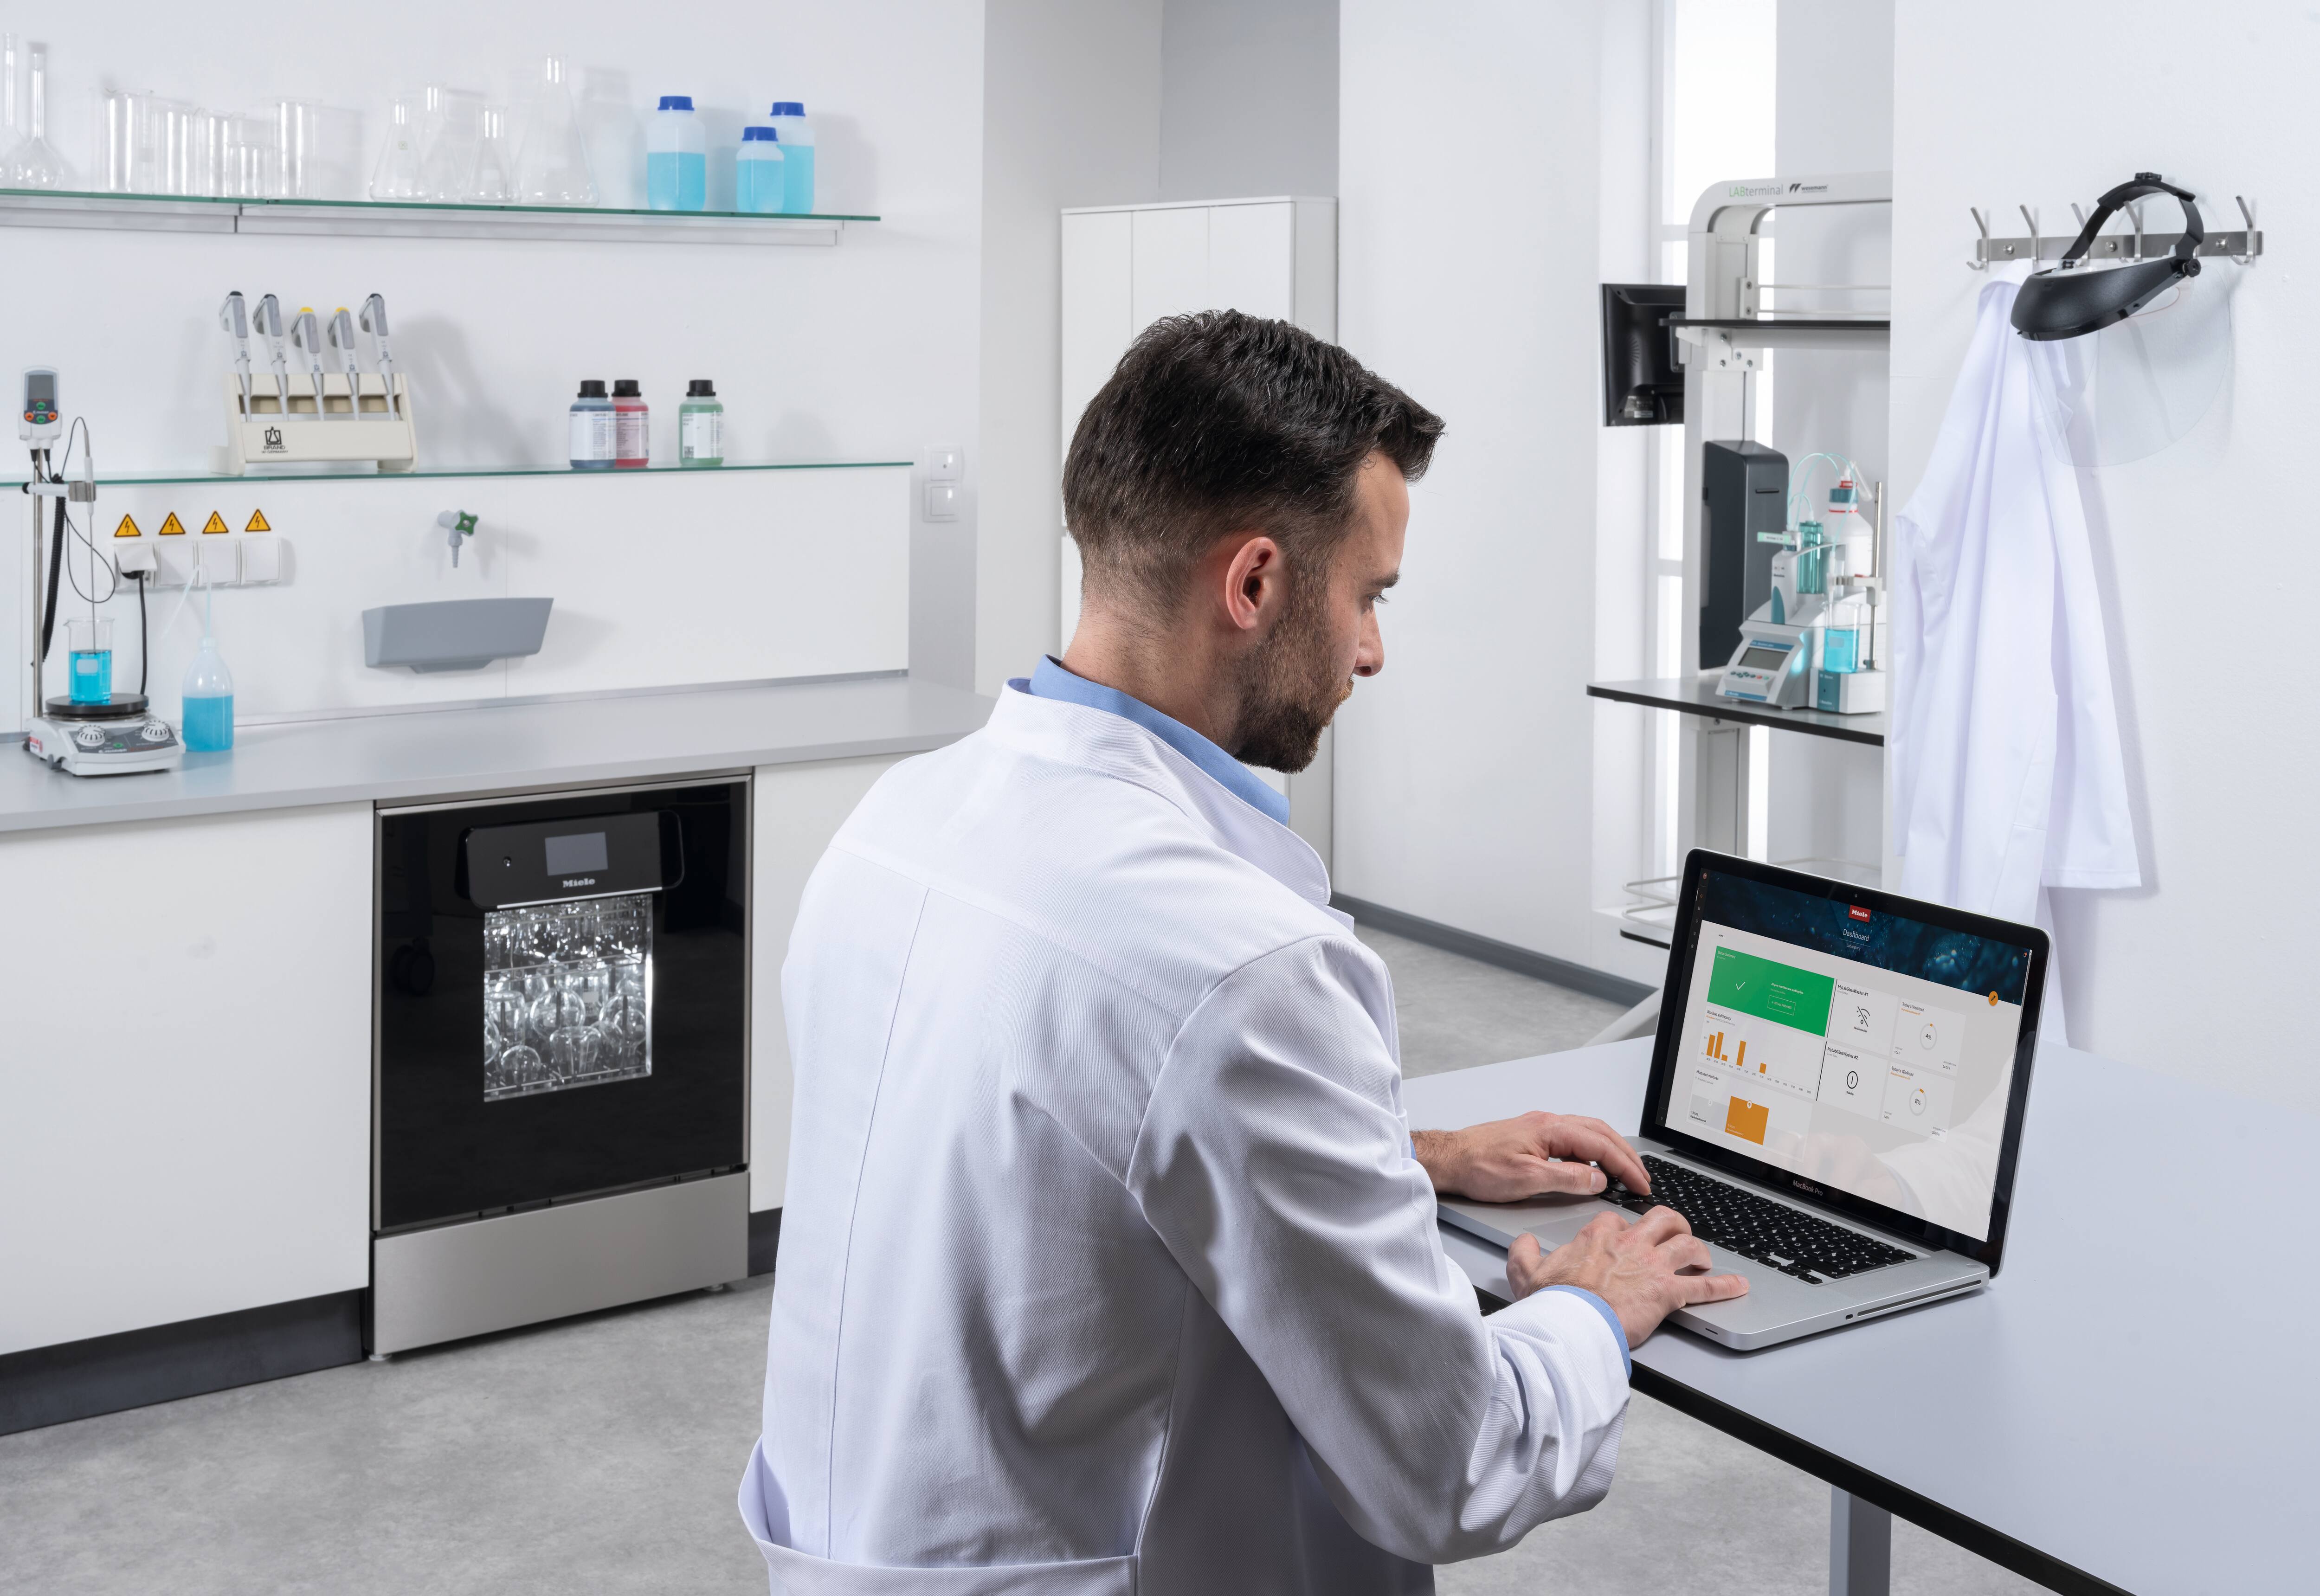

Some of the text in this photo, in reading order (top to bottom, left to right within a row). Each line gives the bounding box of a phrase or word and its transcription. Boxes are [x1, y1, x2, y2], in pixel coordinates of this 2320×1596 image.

[1729, 184, 1784, 197] LABterminal
[562, 878, 595, 888] Miele
[1852, 909, 1868, 918] Miele
[1843, 929, 1869, 941] Dashboard
[1838, 985, 1863, 996] MyLabGlassWasher
[1827, 1047, 1854, 1058] MyLabGlassWasher
[1792, 1180, 1823, 1196] MacBook Pro
